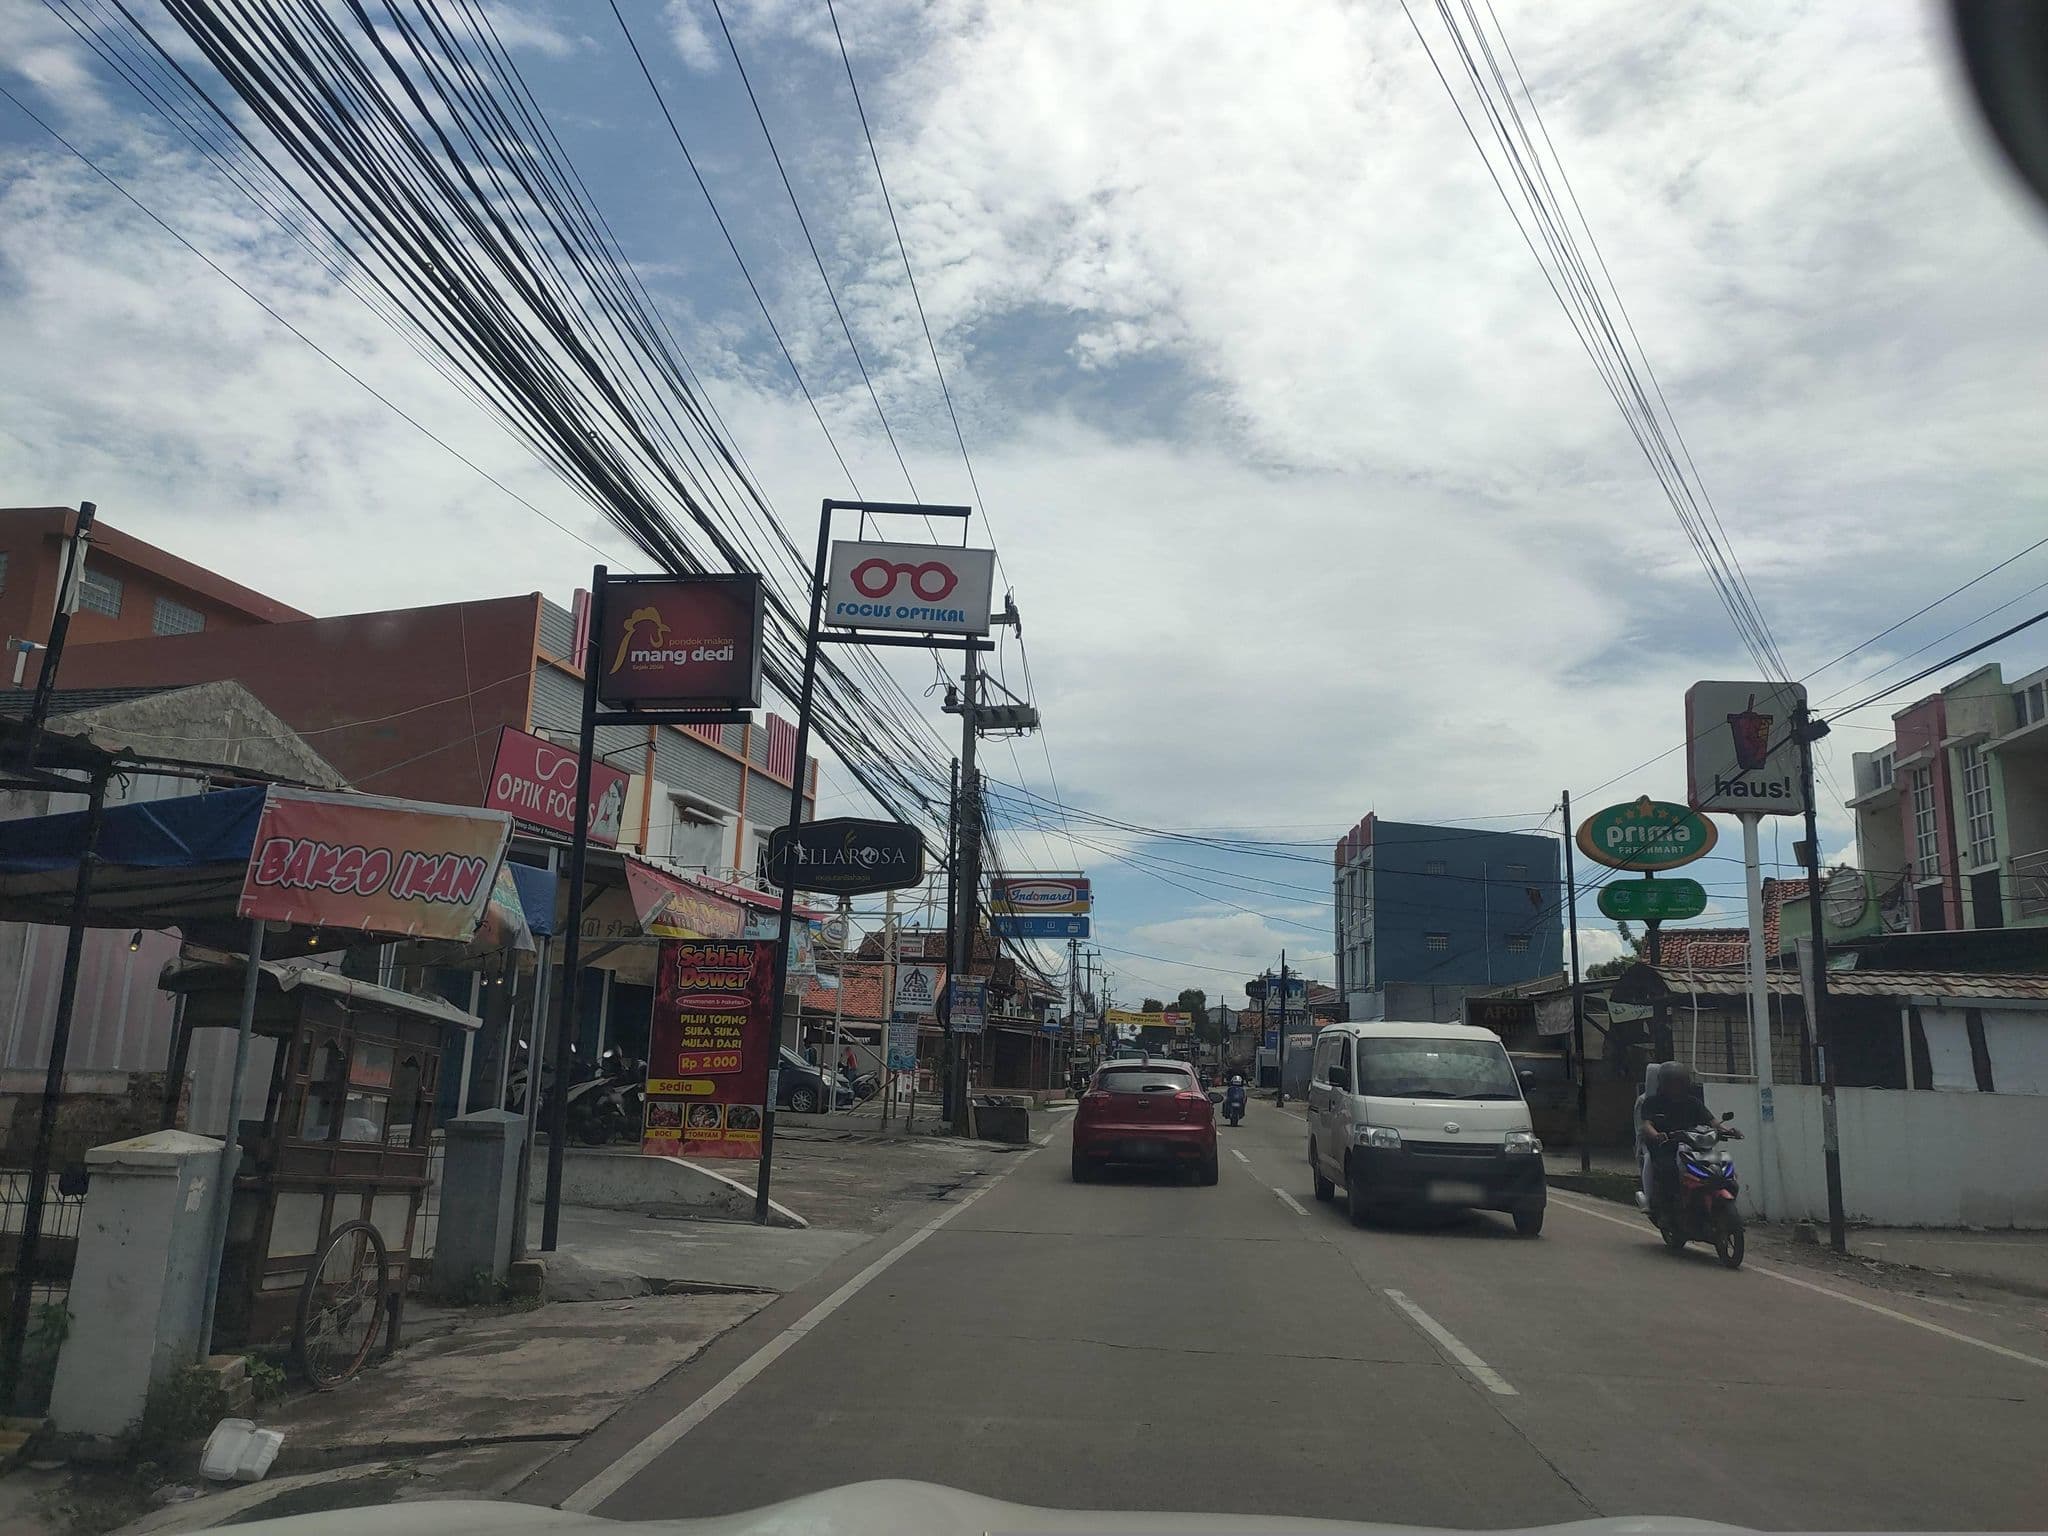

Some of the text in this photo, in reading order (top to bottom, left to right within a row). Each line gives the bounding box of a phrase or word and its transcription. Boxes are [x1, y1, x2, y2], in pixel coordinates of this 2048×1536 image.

[836, 602, 965, 623] FOCUS OPTIKAL
[669, 636, 734, 647] pondok makan
[631, 645, 734, 665] mang dedi
[1714, 774, 1792, 799] haus!
[496, 773, 596, 829] OPTIK FOCS
[1606, 825, 1691, 847] prima
[783, 846, 906, 870] ELLAROSA
[256, 839, 487, 903] BAKSO IKAN
[1011, 889, 1072, 901] Indomaret
[678, 945, 753, 968] Seblak
[679, 966, 750, 990] Dower
[681, 1014, 747, 1025] PILIH TOPING
[685, 1027, 740, 1036] SUKA SUKA
[682, 1039, 742, 1049] MULAI DARI
[682, 1058, 697, 1070] Rp
[660, 1082, 692, 1092] Sedia
